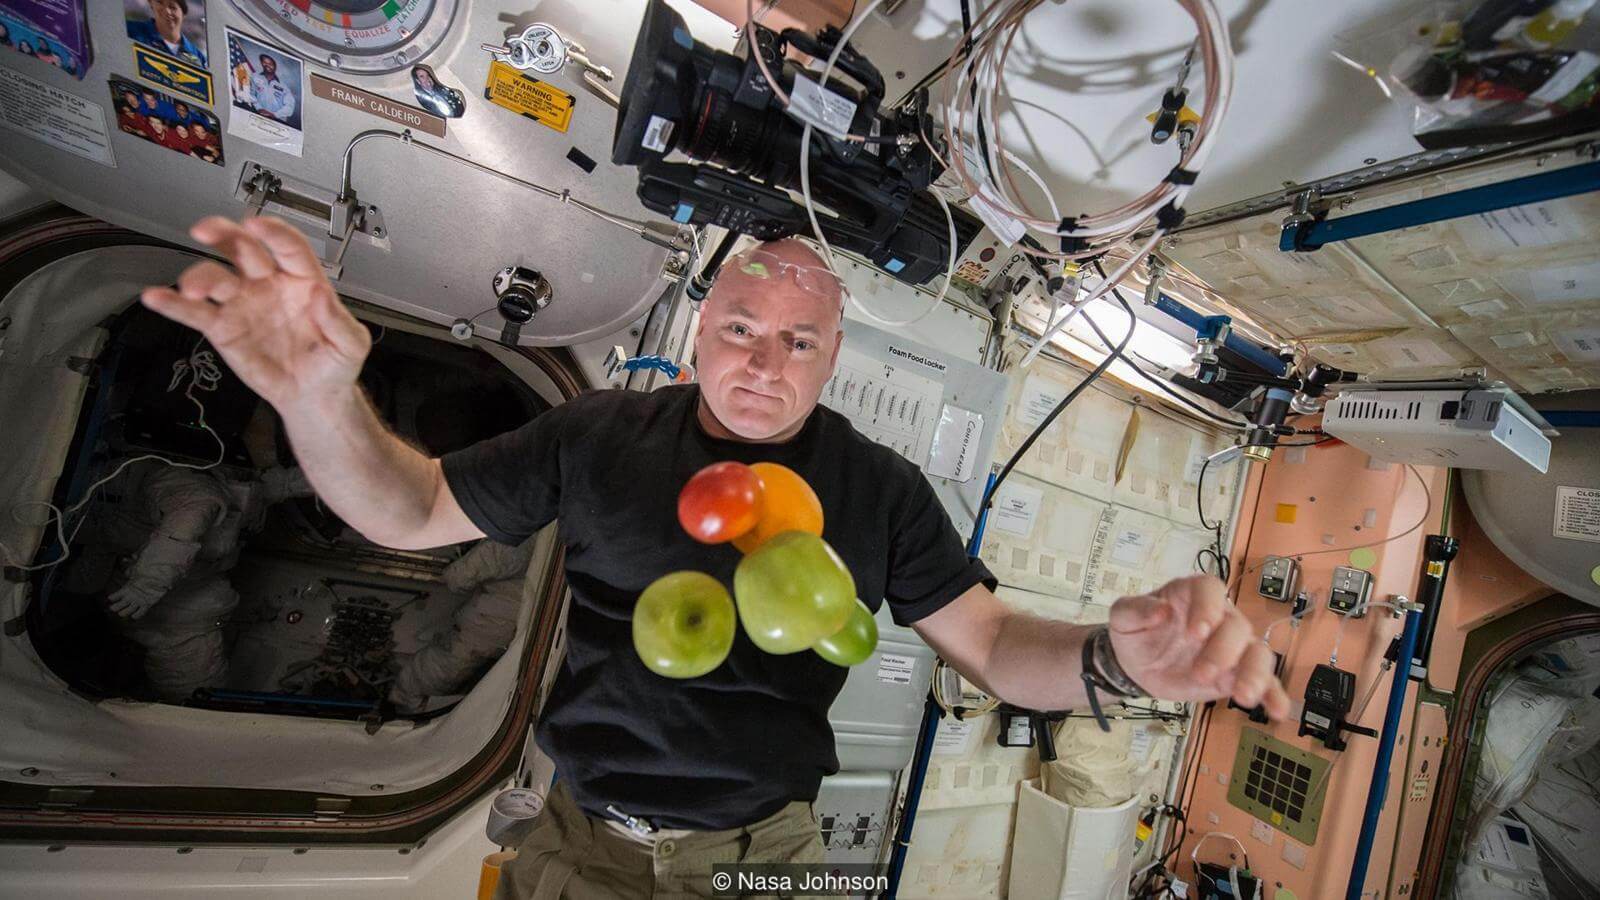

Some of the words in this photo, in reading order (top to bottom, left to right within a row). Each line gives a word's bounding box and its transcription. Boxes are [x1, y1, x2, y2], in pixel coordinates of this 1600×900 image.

[344, 24, 391, 38] EQUALIZE
[512, 78, 552, 102] WARNING
[332, 88, 365, 106] FRANK
[370, 101, 420, 126] CALDEIRO
[888, 346, 908, 358] Foam
[908, 353, 924, 364] Food
[924, 358, 946, 370] Locker
